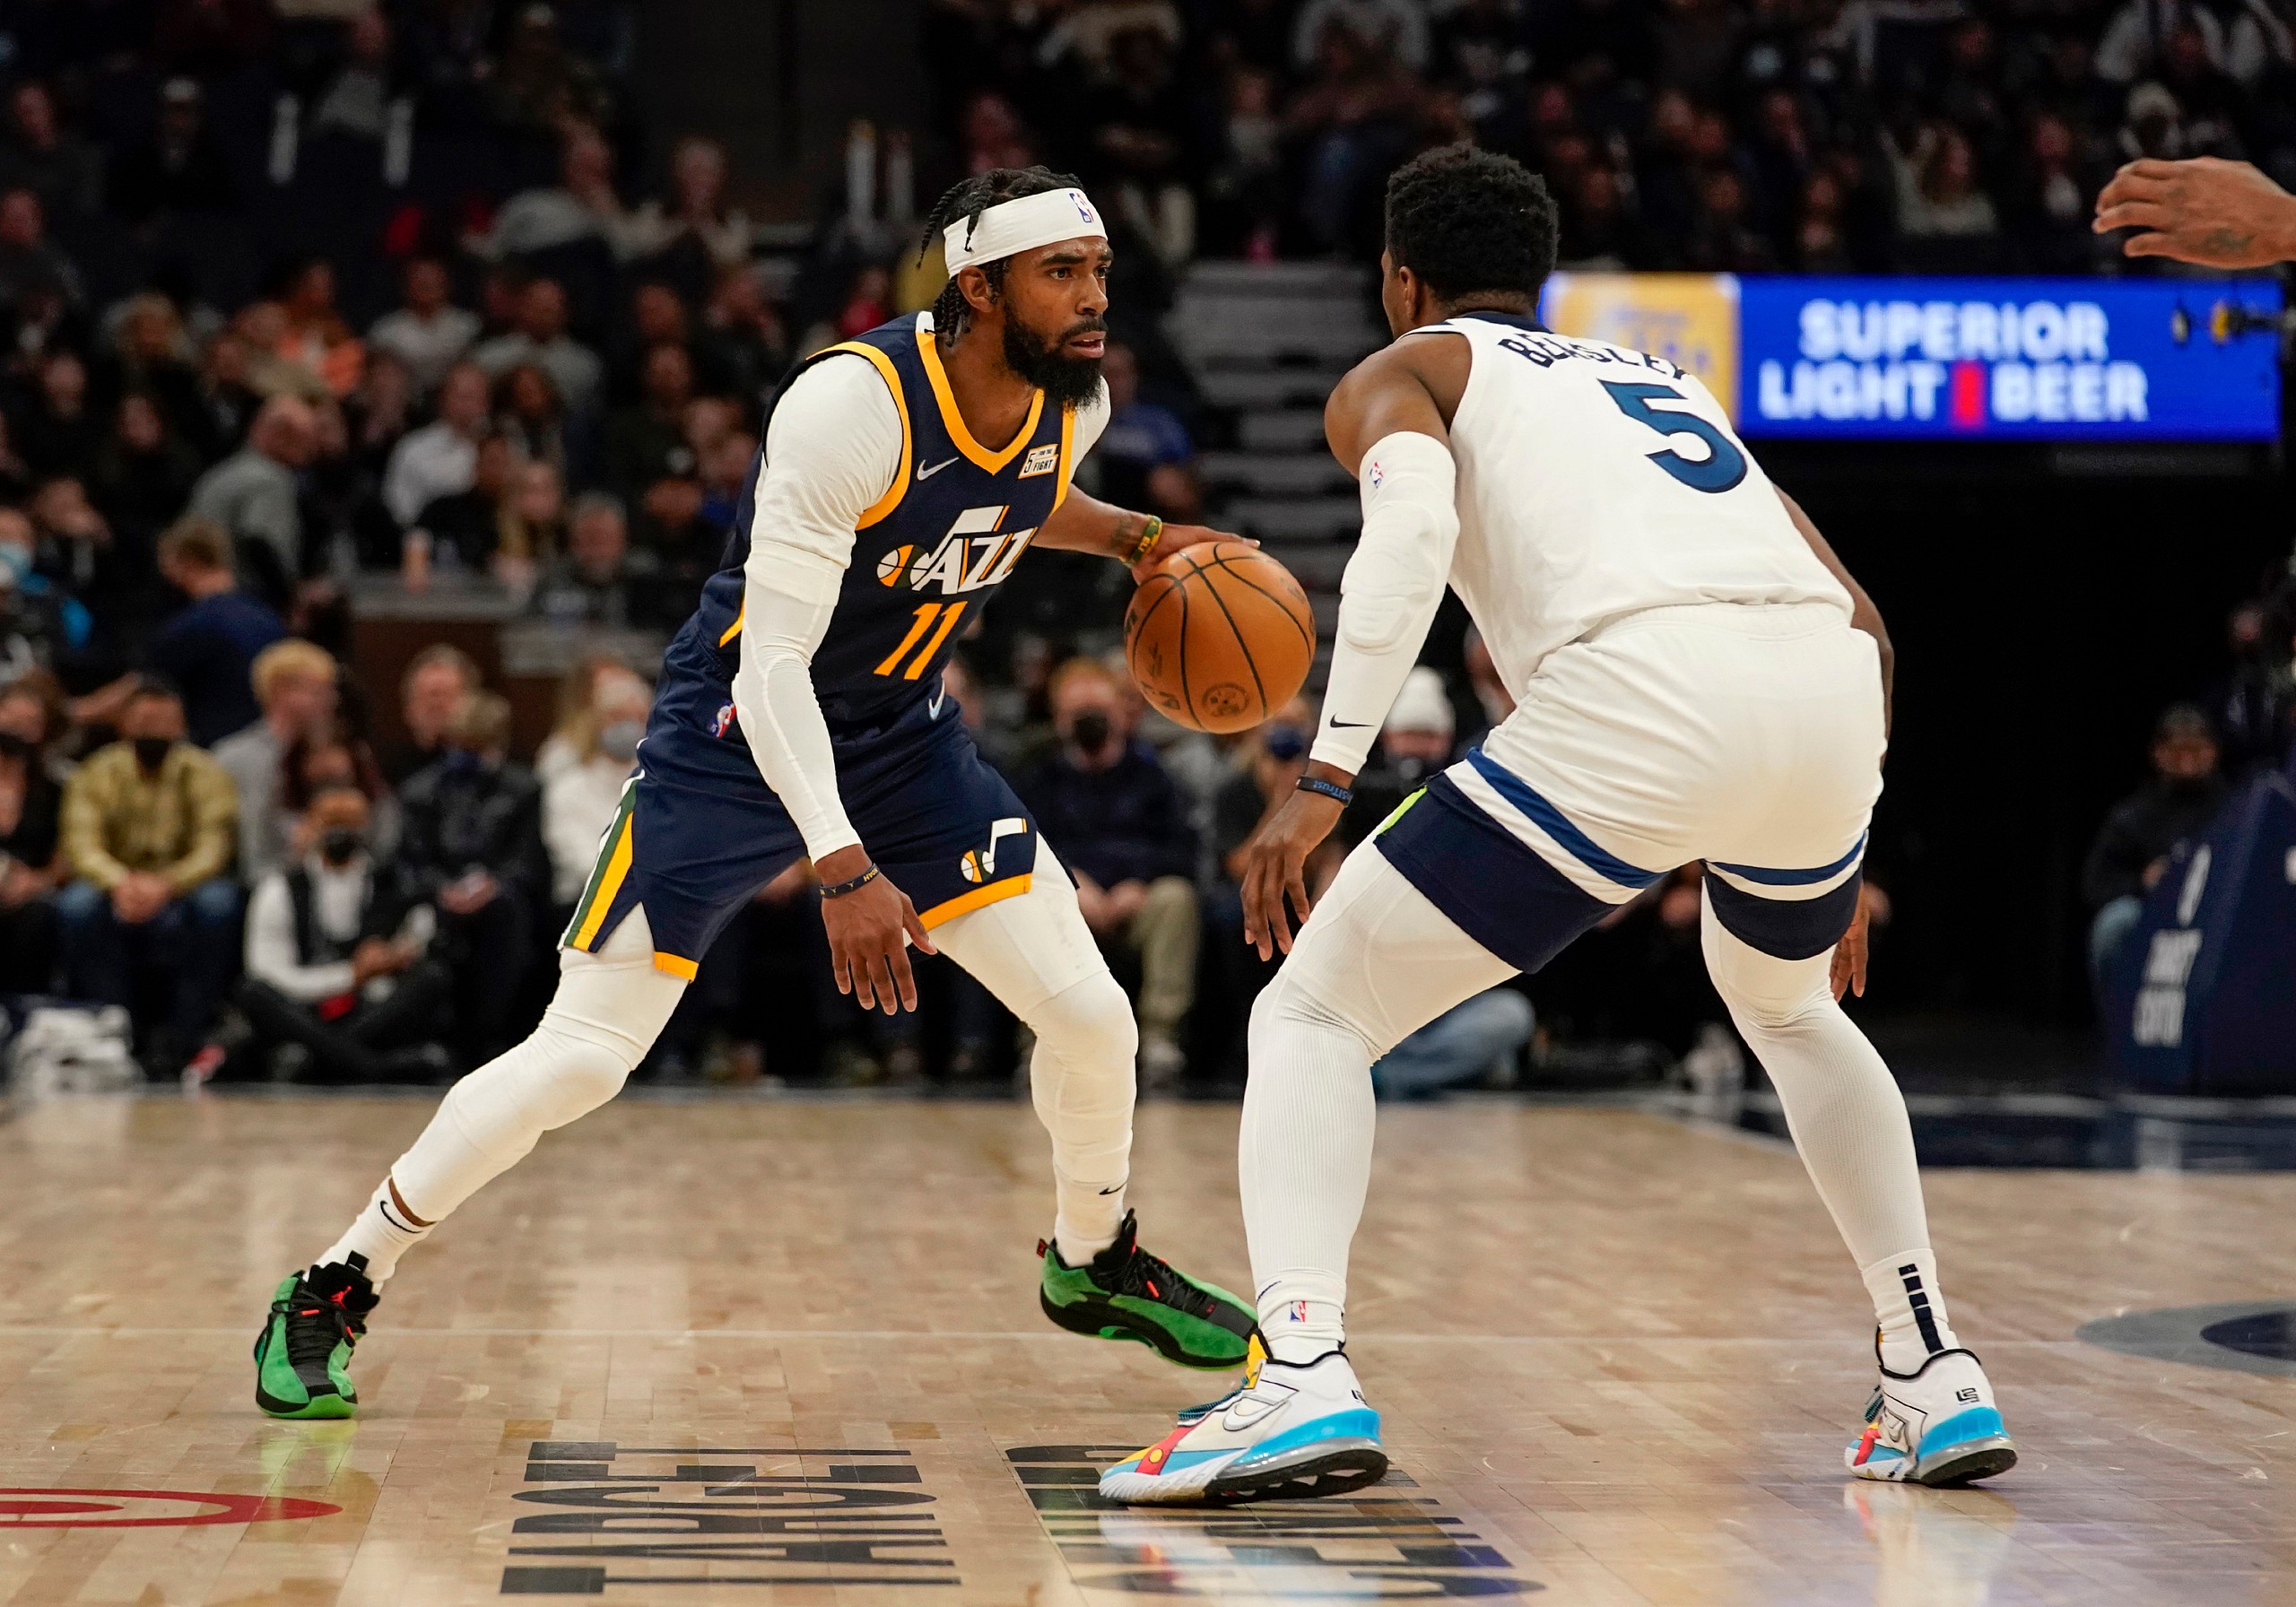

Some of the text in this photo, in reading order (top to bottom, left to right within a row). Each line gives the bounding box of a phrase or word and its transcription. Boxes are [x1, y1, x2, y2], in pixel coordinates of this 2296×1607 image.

[1800, 299, 2109, 360] SUPERIOR
[1759, 359, 2149, 422] LIGHT BEER
[1596, 378, 1748, 493] 5
[874, 601, 968, 681] 11
[500, 1441, 961, 1594] TARGET
